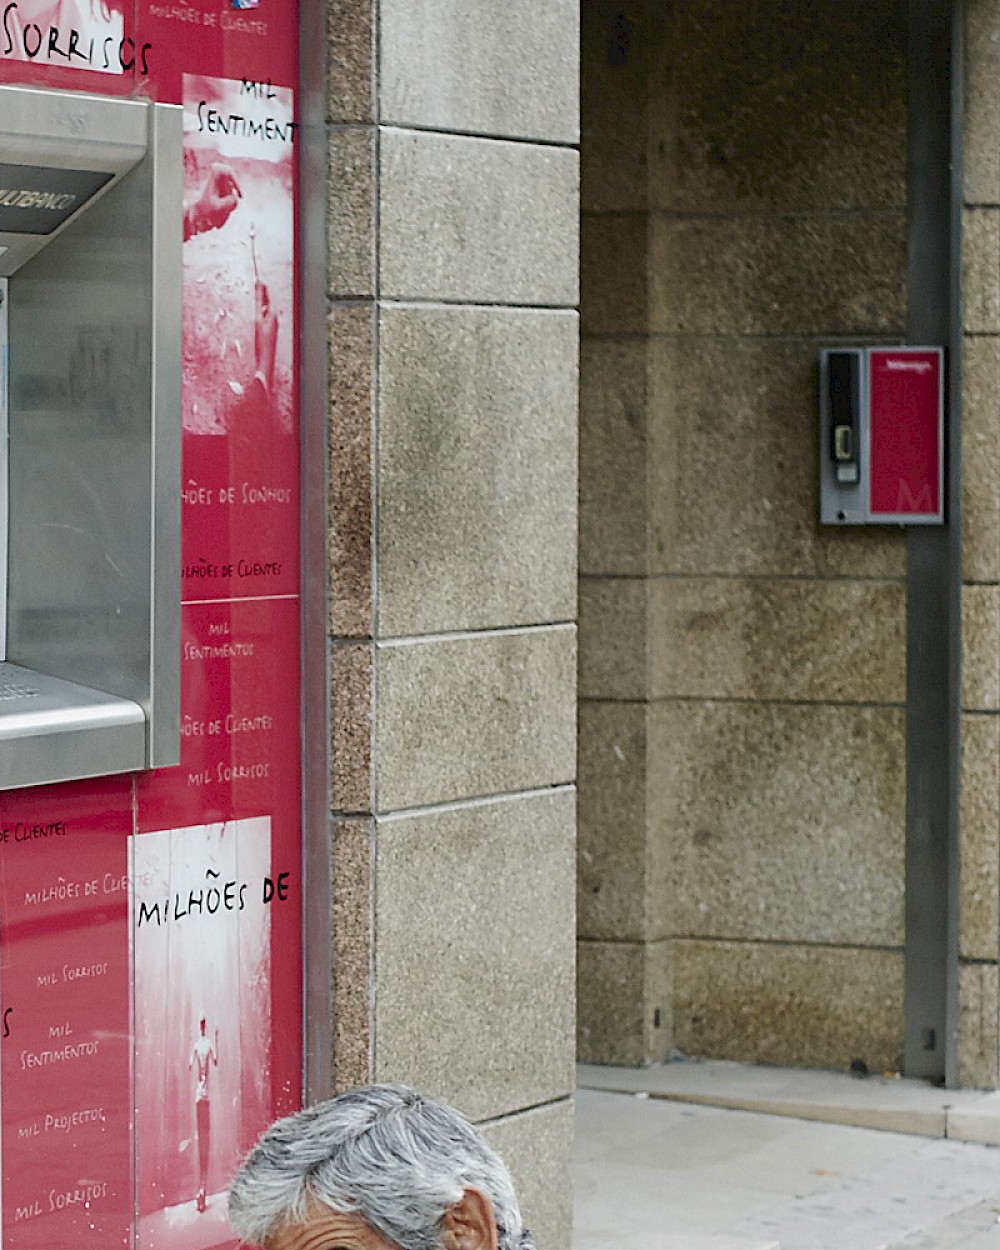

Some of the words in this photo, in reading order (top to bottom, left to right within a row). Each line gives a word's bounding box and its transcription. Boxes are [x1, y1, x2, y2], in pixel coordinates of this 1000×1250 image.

[3, 3, 152, 75] SORRISOS
[240, 77, 276, 99] MIL
[219, 487, 236, 504] DE
[242, 482, 291, 504] SONHOS
[222, 564, 233, 578] DE
[237, 559, 282, 578] CLIENTES
[208, 623, 231, 636] MIL
[184, 641, 254, 661] SENTIMENTOS
[208, 720, 222, 735] DE
[225, 714, 273, 735] CLIENTES
[187, 770, 213, 787] MIL
[14, 821, 67, 843] CLIENTES
[24, 876, 80, 905] MILHÕES
[84, 880, 98, 896] DE
[138, 868, 247, 928] MILHÕES
[262, 872, 290, 904] DE
[37, 973, 58, 988] MIL
[62, 962, 108, 983] SORRISOS
[48, 1021, 73, 1039] MIL
[20, 1041, 99, 1070] SENTIMENTOS
[18, 1123, 41, 1139] MIL
[44, 1108, 105, 1134] PROJECTOS
[14, 1202, 43, 1222] MIL
[49, 1182, 107, 1212] SORRISOS
